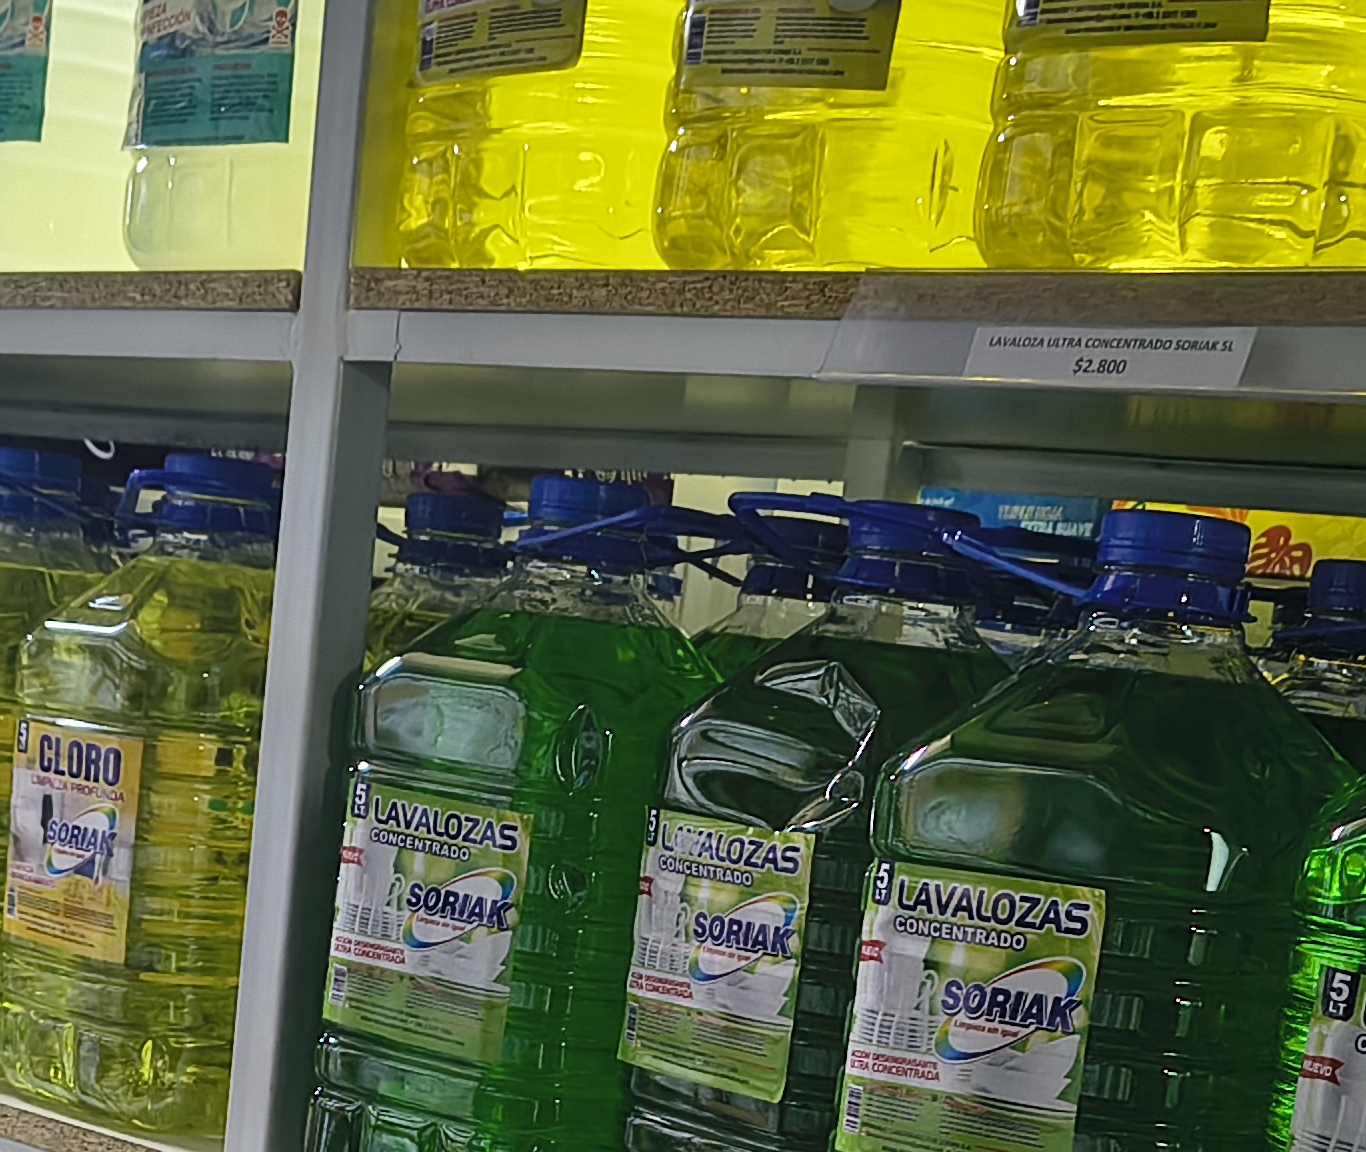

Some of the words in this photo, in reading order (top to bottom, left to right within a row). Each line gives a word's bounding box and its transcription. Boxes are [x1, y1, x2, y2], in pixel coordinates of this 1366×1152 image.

[989, 336, 1044, 348] LAVALOZA
[1047, 337, 1082, 349] ULTRA
[1085, 337, 1172, 351] CONCENTRADO
[1174, 339, 1218, 352] SORIAK
[1072, 356, 1128, 375] $2.800
[39, 734, 123, 787] CLORO
[355, 783, 366, 804] 5
[374, 797, 519, 851] LAVALOZAS
[649, 809, 658, 832] 5
[47, 819, 117, 858] SORIAK
[370, 829, 471, 861] CONCENTRADO
[662, 824, 801, 874] LAVALOZAS
[659, 855, 753, 887] CONCENTRADO
[877, 863, 890, 888] 5
[407, 882, 514, 930] SORIAK
[898, 878, 1090, 936] LAVALOZAS
[694, 912, 797, 957] SORIAK
[895, 916, 1027, 951] CONCENTRADO
[1329, 973, 1351, 1002] 5
[942, 979, 1083, 1032] SORIAK
[1329, 1001, 1347, 1016] LT
[872, 1063, 940, 1081] CONCENTRADA
